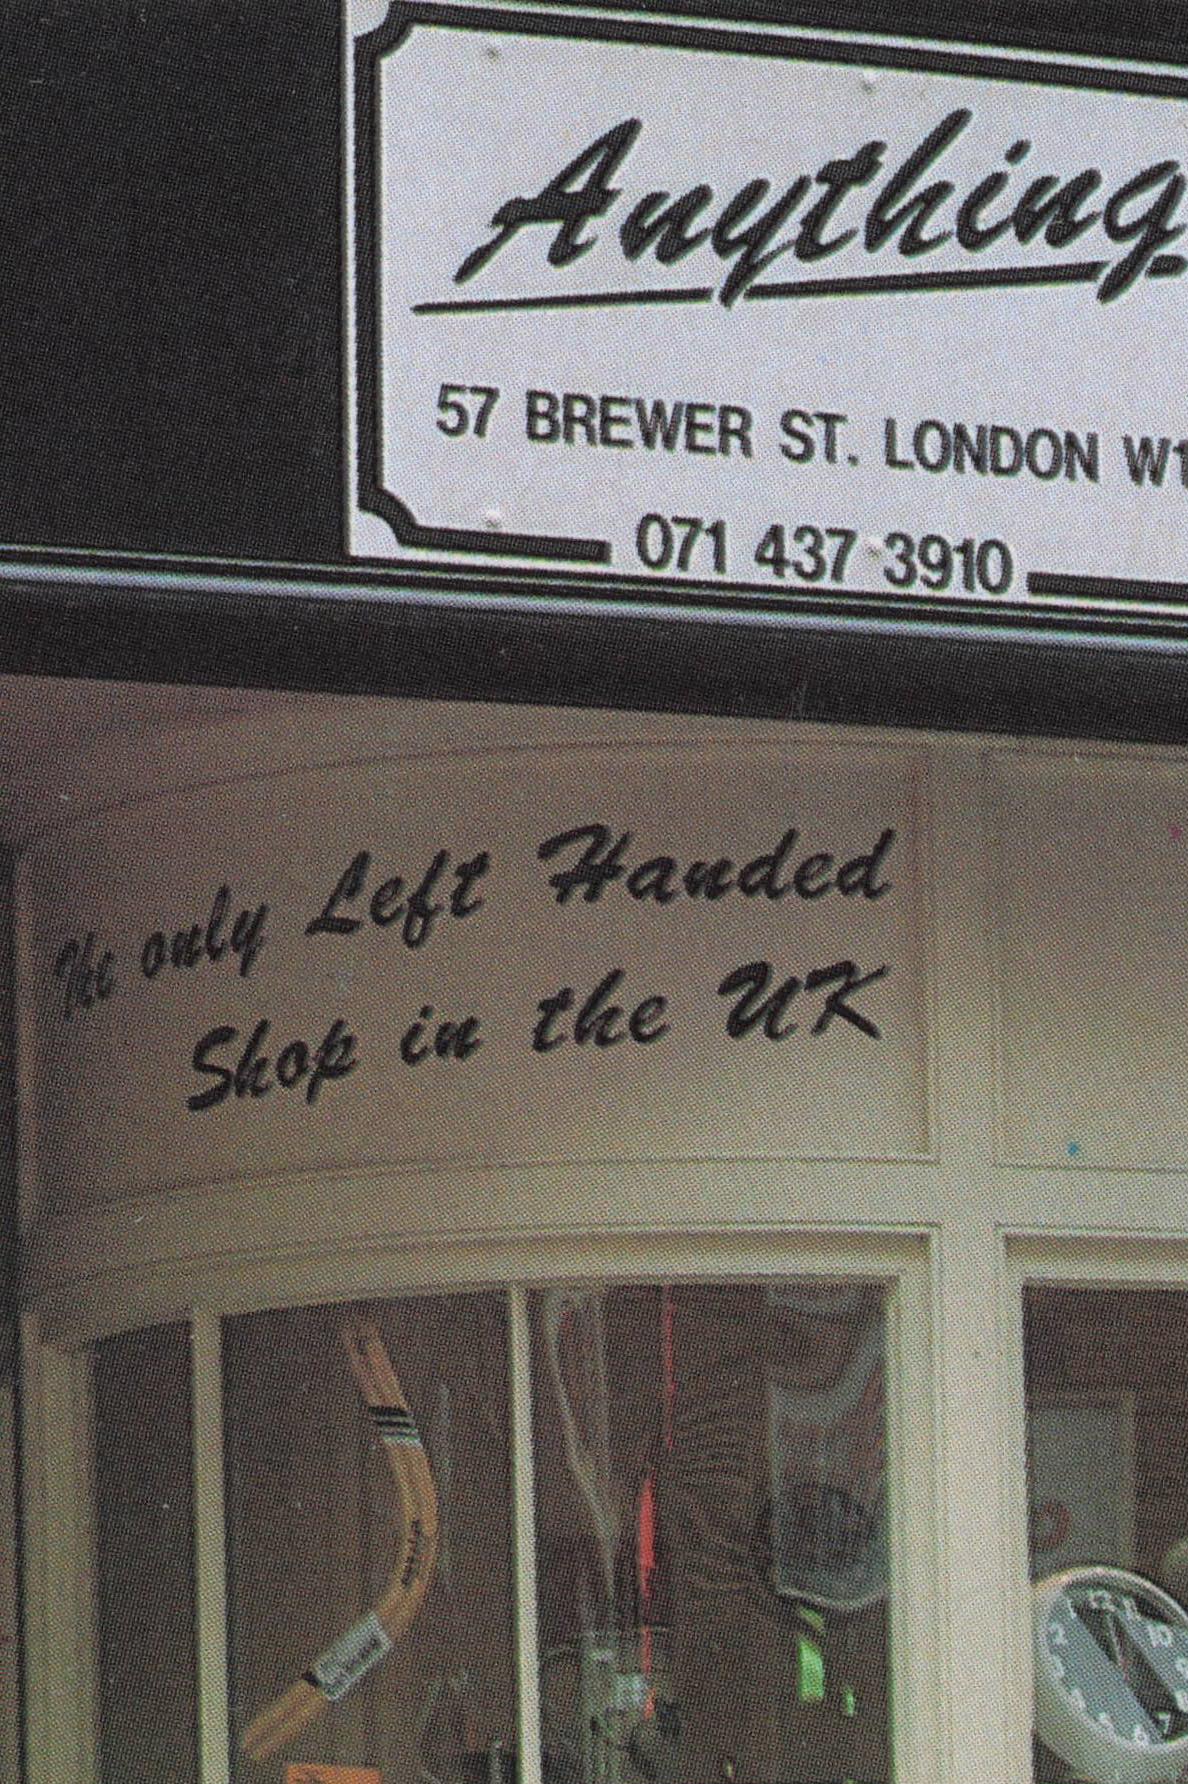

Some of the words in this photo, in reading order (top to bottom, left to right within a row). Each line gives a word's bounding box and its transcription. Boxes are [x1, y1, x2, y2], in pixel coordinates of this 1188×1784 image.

[436, 383, 499, 438] 57
[525, 389, 752, 458] BREWER
[779, 408, 858, 467] ST.
[884, 417, 1099, 483] LONDON
[635, 513, 727, 573] 071
[754, 523, 858, 584] 437
[882, 532, 1013, 594] 3910
[141, 884, 269, 979] only
[304, 848, 491, 950] Left
[537, 822, 896, 905] Handed
[187, 1018, 359, 1112] Shop
[399, 1005, 483, 1067] in
[531, 968, 671, 1054] the
[717, 959, 890, 1042] UK
[1145, 1622, 1174, 1648] 10
